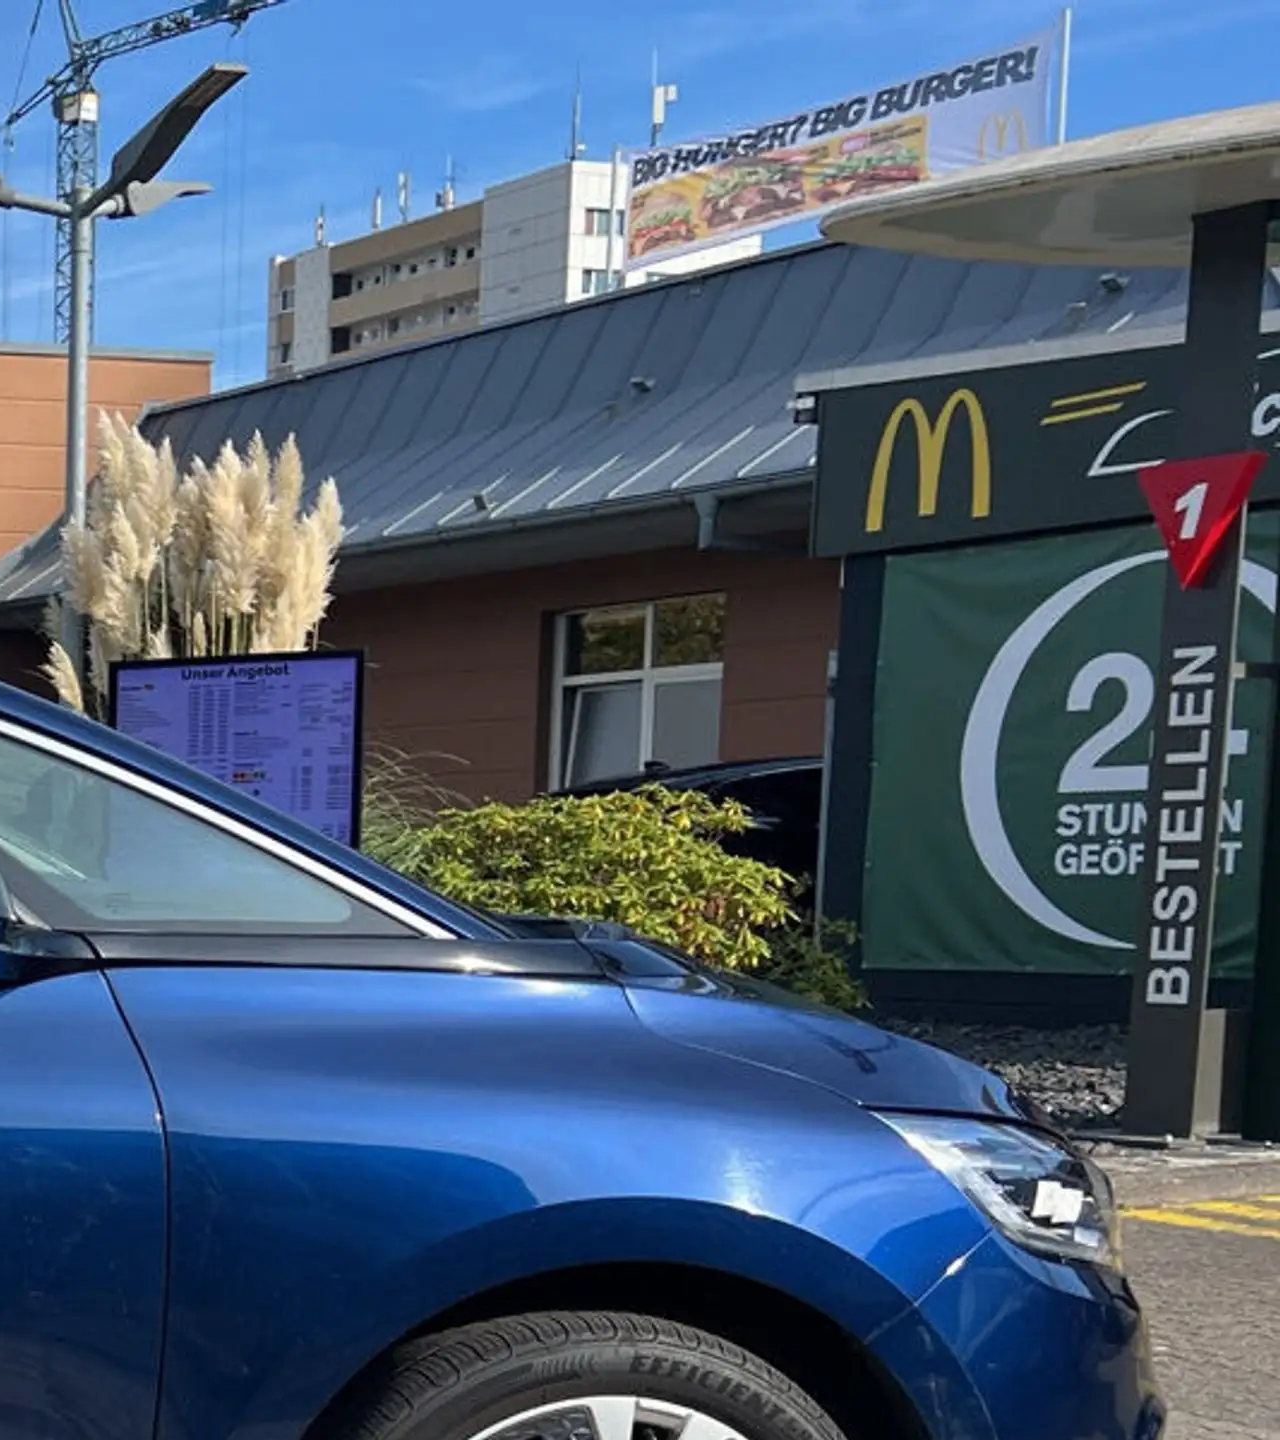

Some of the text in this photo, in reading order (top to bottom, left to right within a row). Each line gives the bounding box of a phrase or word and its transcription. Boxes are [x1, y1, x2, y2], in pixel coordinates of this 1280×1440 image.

[632, 150, 669, 188] BIG
[671, 114, 808, 173] HUNGER?
[808, 97, 868, 139] BIG
[869, 46, 1039, 121] BURGER!
[1174, 482, 1209, 540] 1
[180, 663, 290, 681] Unser Angebot
[1055, 800, 1244, 838] STUNN
[1145, 644, 1217, 1005] BESTELLEN
[1054, 839, 1243, 876] GEÖFT
